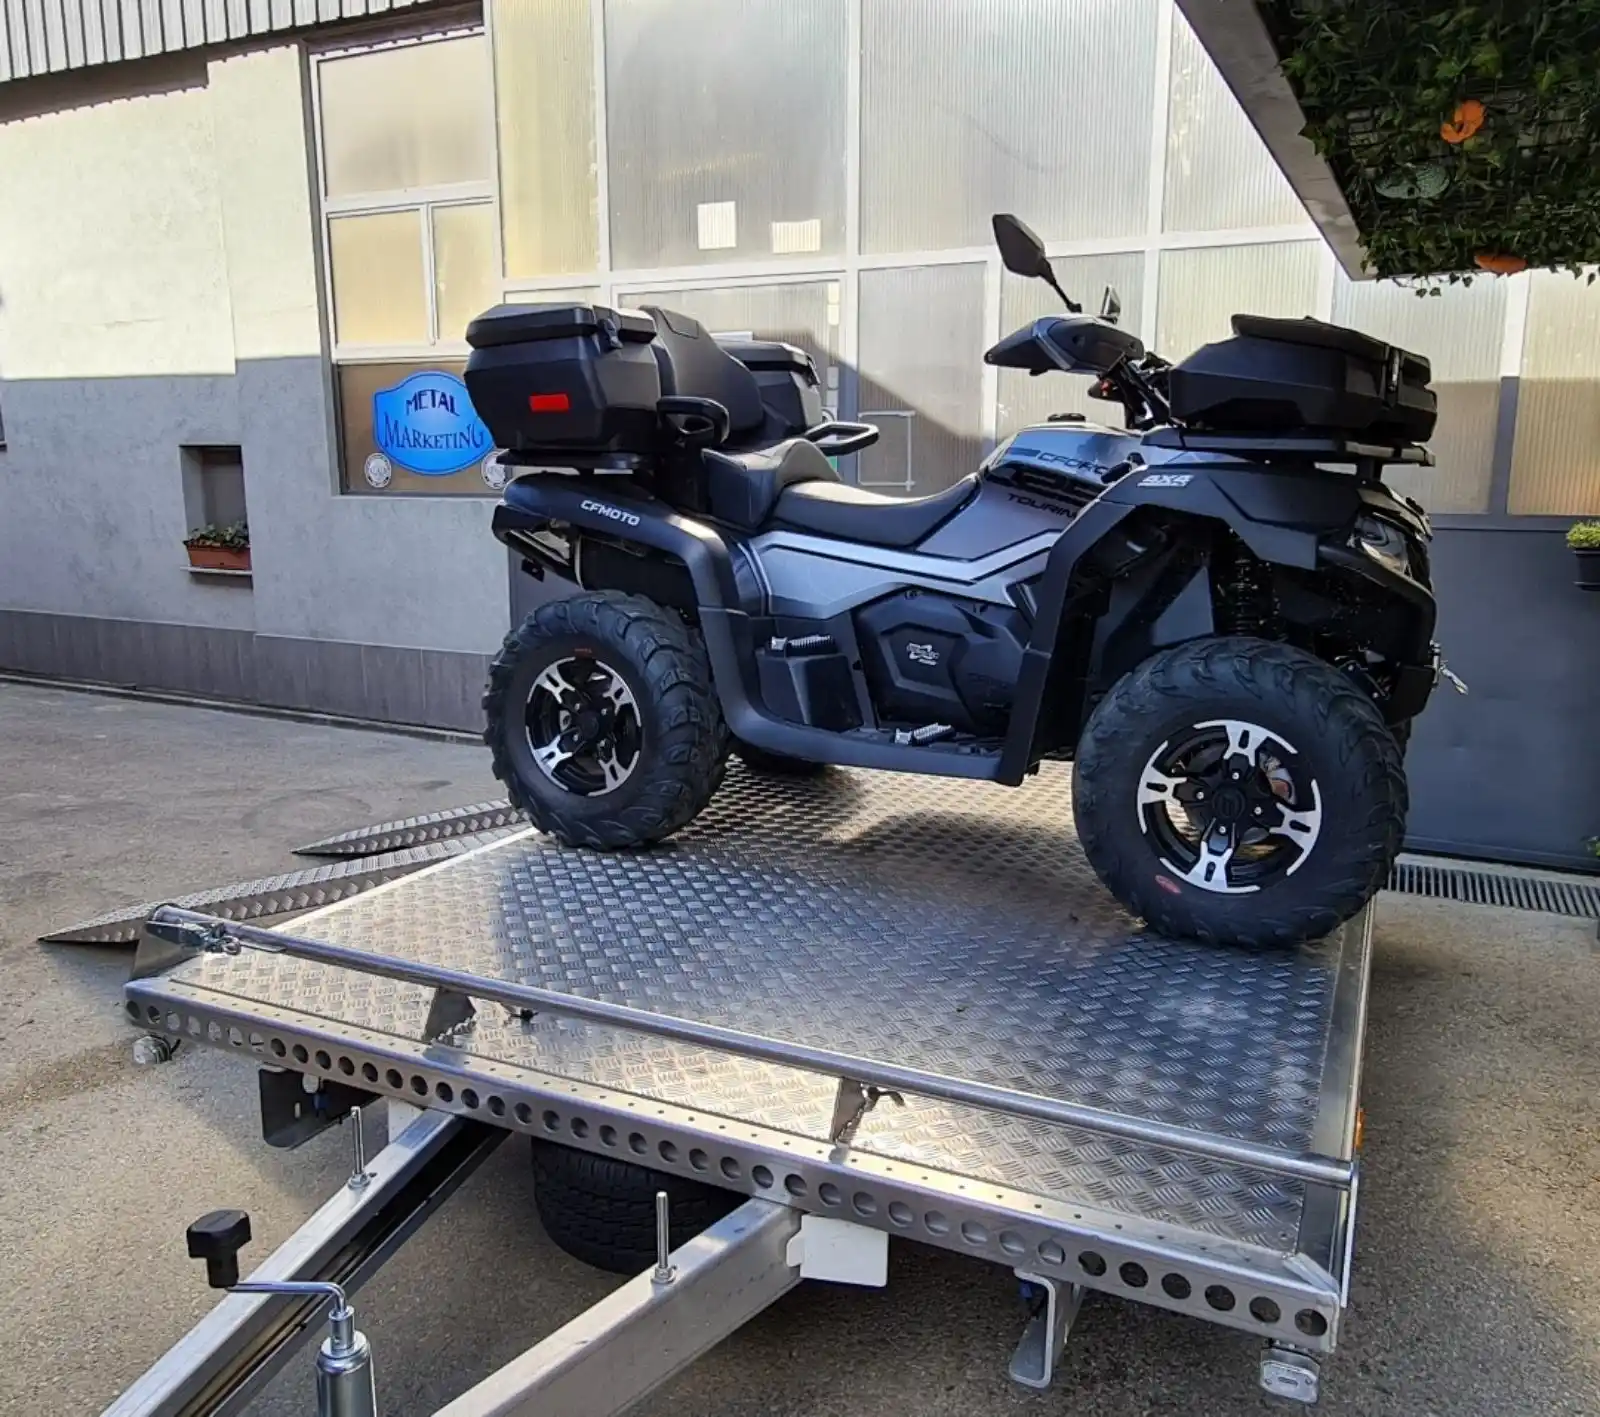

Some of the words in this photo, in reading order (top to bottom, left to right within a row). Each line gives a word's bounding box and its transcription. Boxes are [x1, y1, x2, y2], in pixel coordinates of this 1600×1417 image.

[406, 389, 460, 416] METAL
[384, 411, 484, 449] MARKETING
[1037, 452, 1109, 475] CFORC
[580, 499, 640, 526] CFMOTO
[1008, 493, 1078, 518] TOURIN
